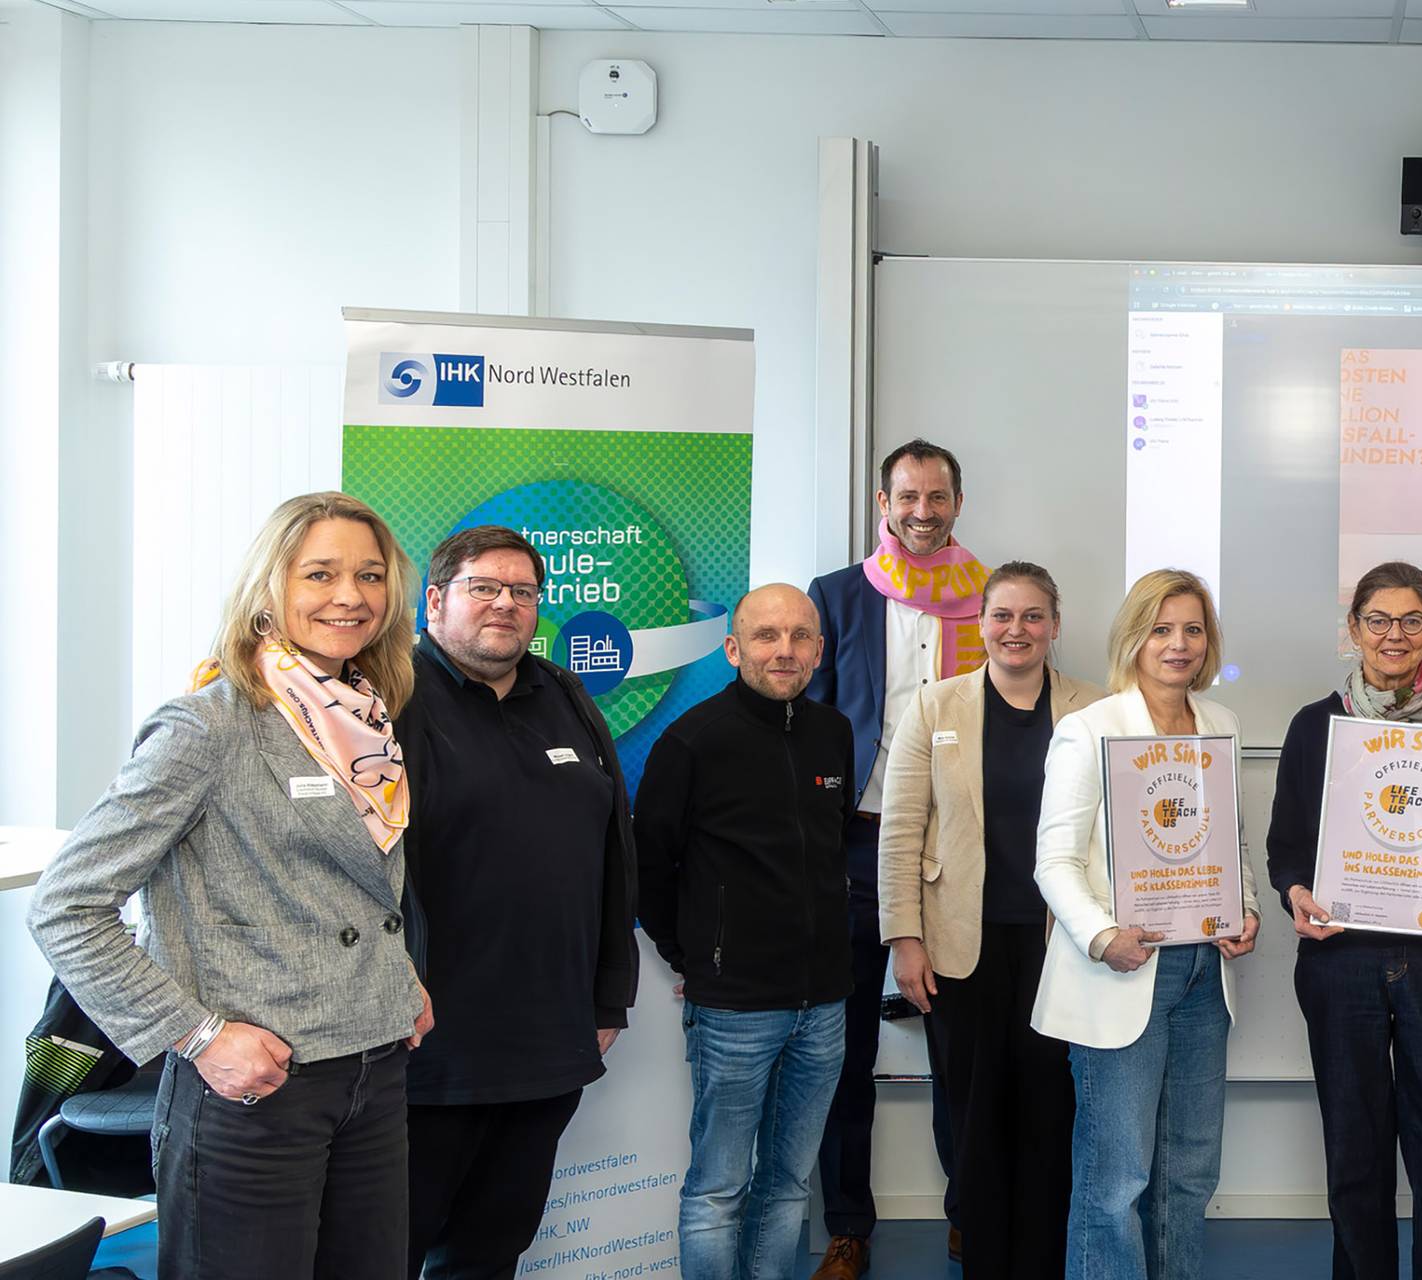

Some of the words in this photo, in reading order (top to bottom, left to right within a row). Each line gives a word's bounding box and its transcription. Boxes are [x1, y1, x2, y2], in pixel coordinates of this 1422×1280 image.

[1343, 351, 1370, 364] AS
[440, 362, 481, 382] IHK
[489, 365, 534, 384] Nord
[540, 367, 631, 387] Westfalen
[1342, 427, 1417, 444] SFALL-
[519, 526, 642, 545] tnerschaft
[1146, 772, 1199, 795] OFFIZIELLE
[1390, 785, 1419, 796] LIFE
[1162, 797, 1184, 808] LIFE
[1388, 805, 1406, 815] US
[1162, 808, 1197, 818] TEACH
[1140, 807, 1210, 855] PARTNERSCHULE
[1163, 819, 1177, 828] US
[1342, 850, 1362, 860] UND
[1365, 852, 1396, 864] HOLEN
[1399, 854, 1419, 865] DAS
[1130, 868, 1148, 880] UND
[1150, 867, 1176, 878] HOLEN
[1178, 866, 1195, 877] DAS
[1197, 865, 1223, 876] LEBEN
[553, 1152, 638, 1180] ordwestfalen
[544, 1172, 677, 1214] ges/ihknordwestfalen
